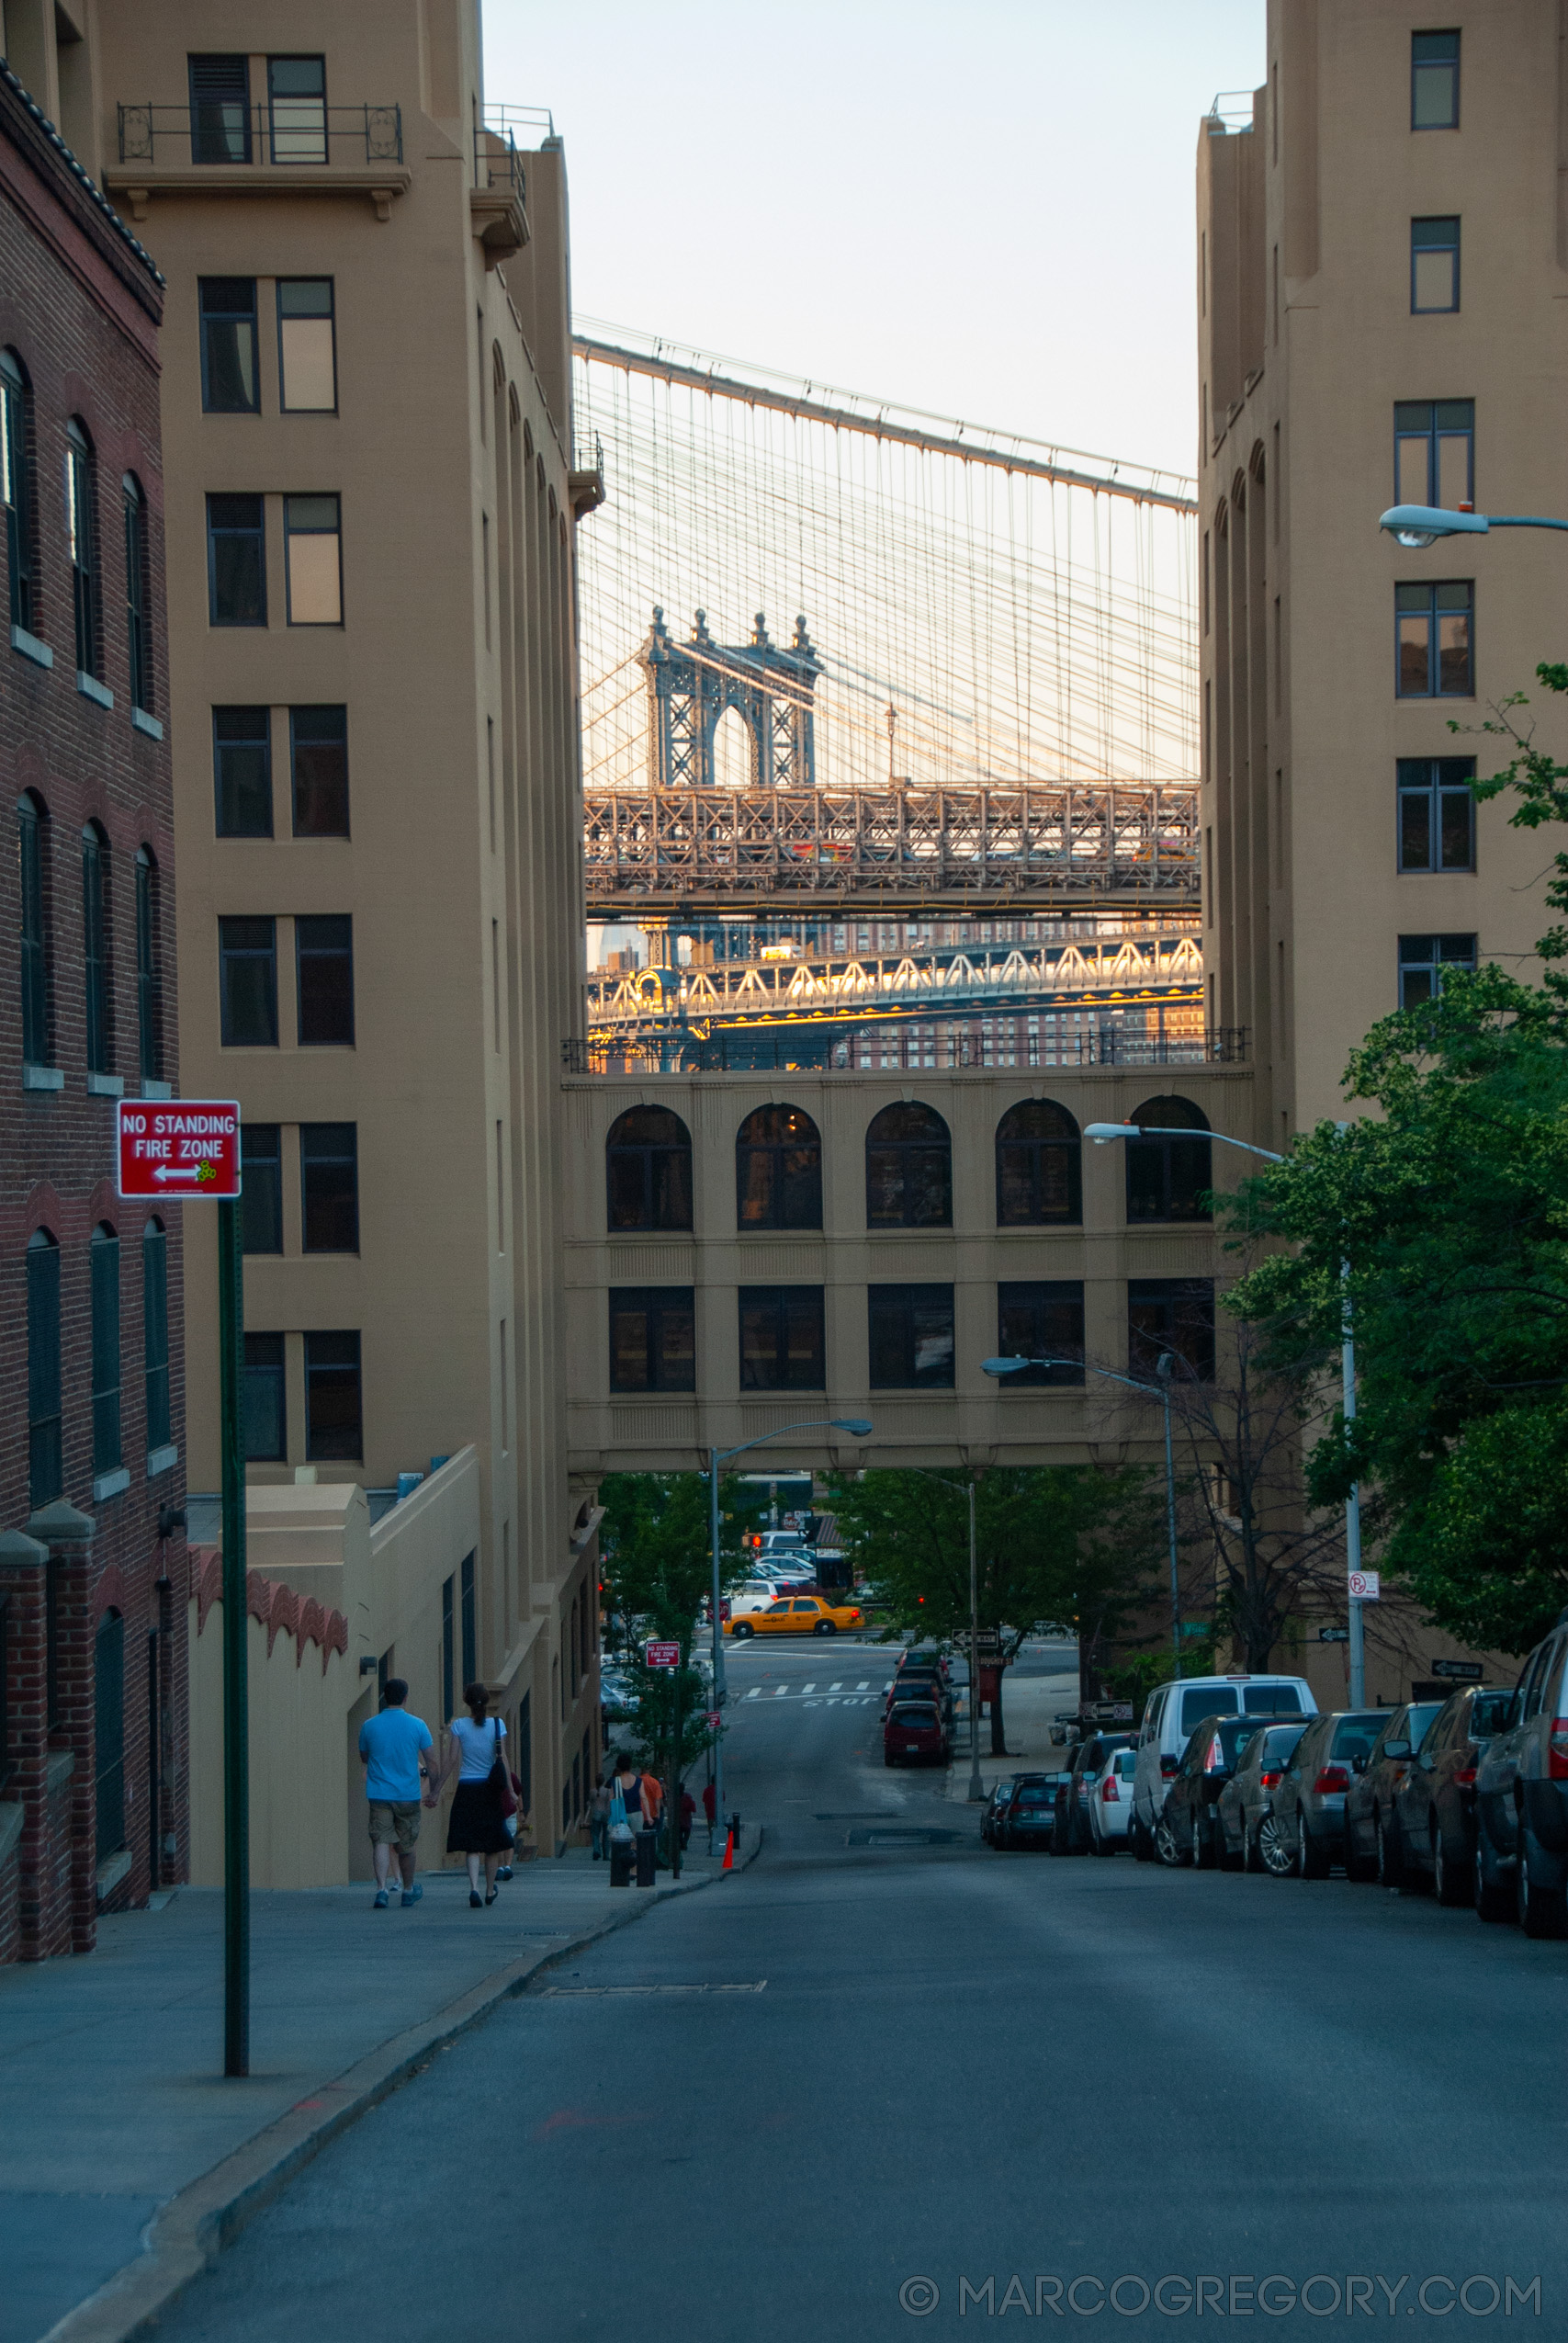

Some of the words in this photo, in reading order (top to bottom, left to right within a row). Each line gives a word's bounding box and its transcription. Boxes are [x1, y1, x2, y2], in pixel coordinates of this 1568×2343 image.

[123, 1115, 147, 1134] NO
[154, 1115, 235, 1134] STANDING
[135, 1139, 173, 1158] FIRE
[180, 1139, 224, 1158] ZONE
[708, 1605, 728, 1615] SOP
[802, 1697, 879, 1707] STOP
